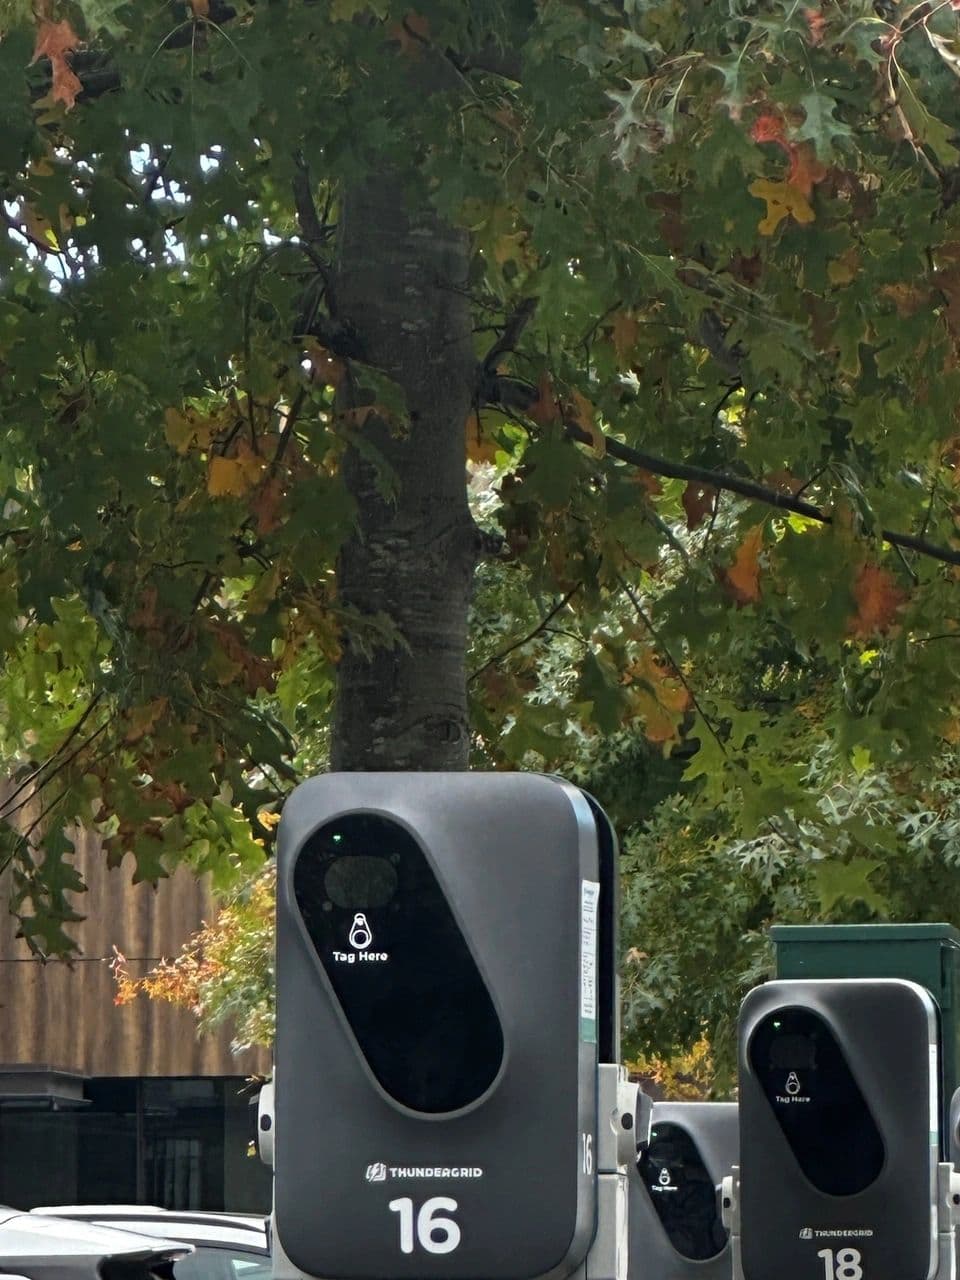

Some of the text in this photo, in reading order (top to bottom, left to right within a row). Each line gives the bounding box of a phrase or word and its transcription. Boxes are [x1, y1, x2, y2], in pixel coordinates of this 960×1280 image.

[333, 951, 355, 963] Tag
[582, 1132, 592, 1175] 16
[389, 1167, 483, 1178] THUNDERGRID
[388, 1196, 461, 1254] 16
